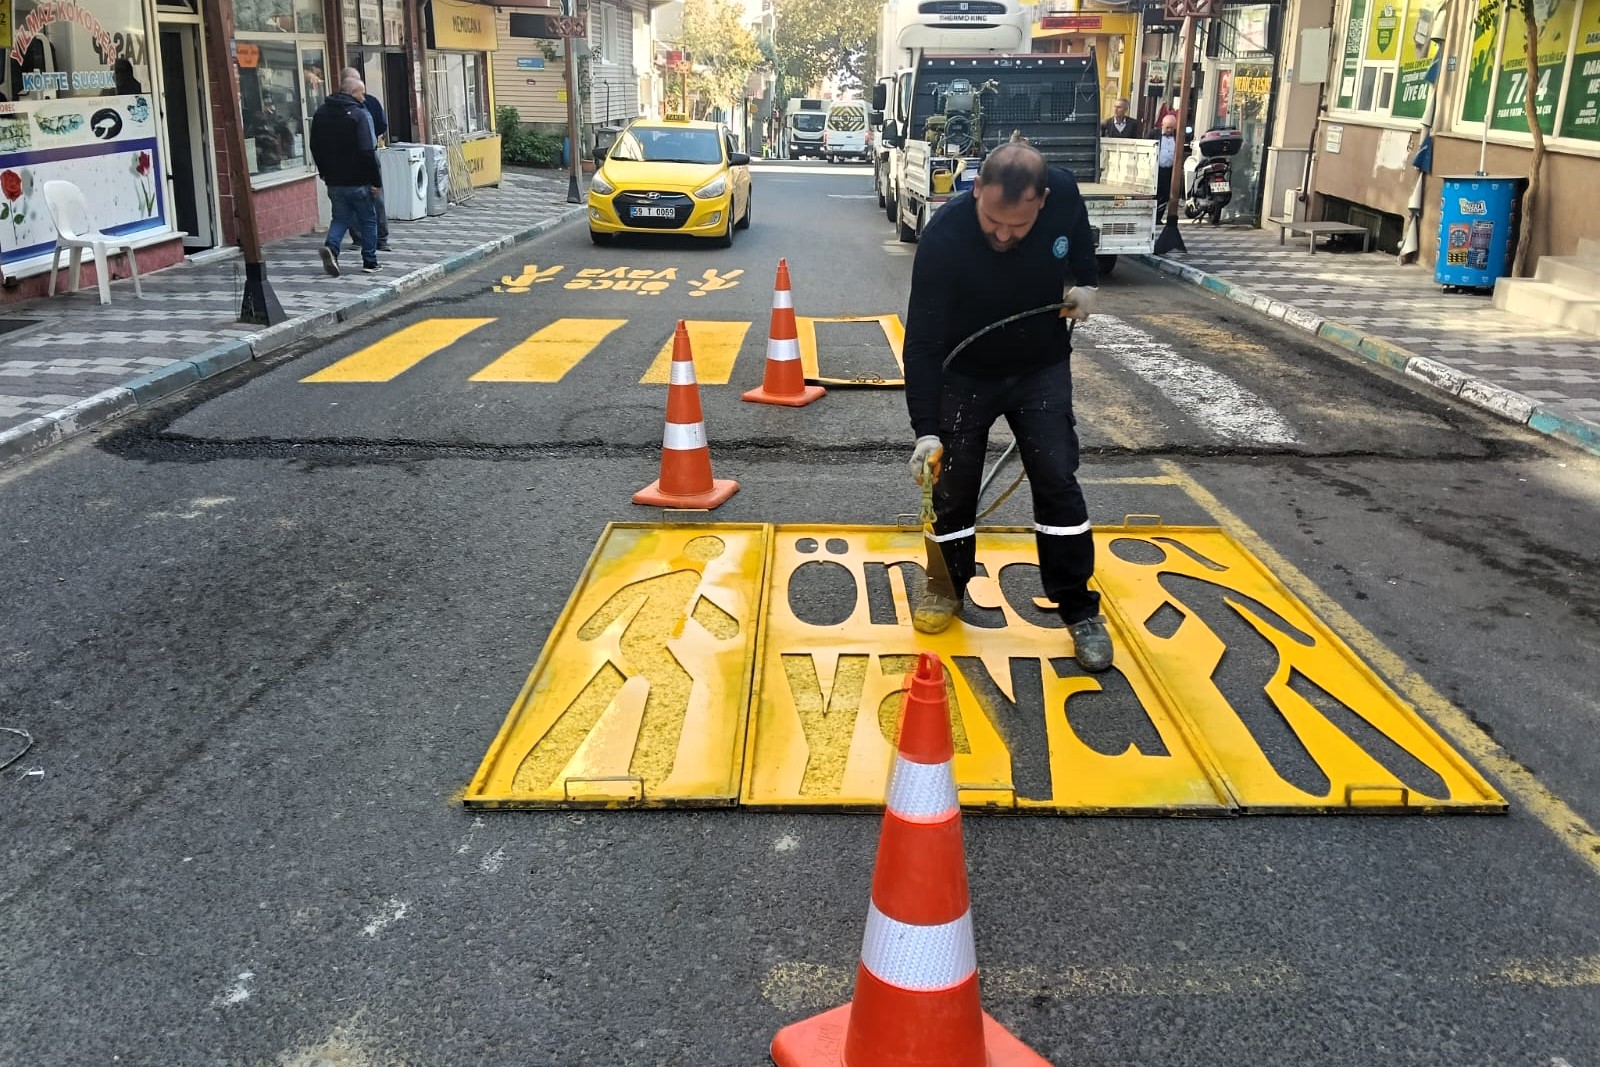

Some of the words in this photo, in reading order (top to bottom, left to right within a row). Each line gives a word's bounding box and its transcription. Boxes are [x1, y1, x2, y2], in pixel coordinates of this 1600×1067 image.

[22, 68, 68, 91] KÖFTE
[72, 71, 116, 90] SUCUK
[1506, 69, 1551, 104] 7/4
[1402, 83, 1419, 102] ÜYE
[1417, 83, 1428, 101] OL
